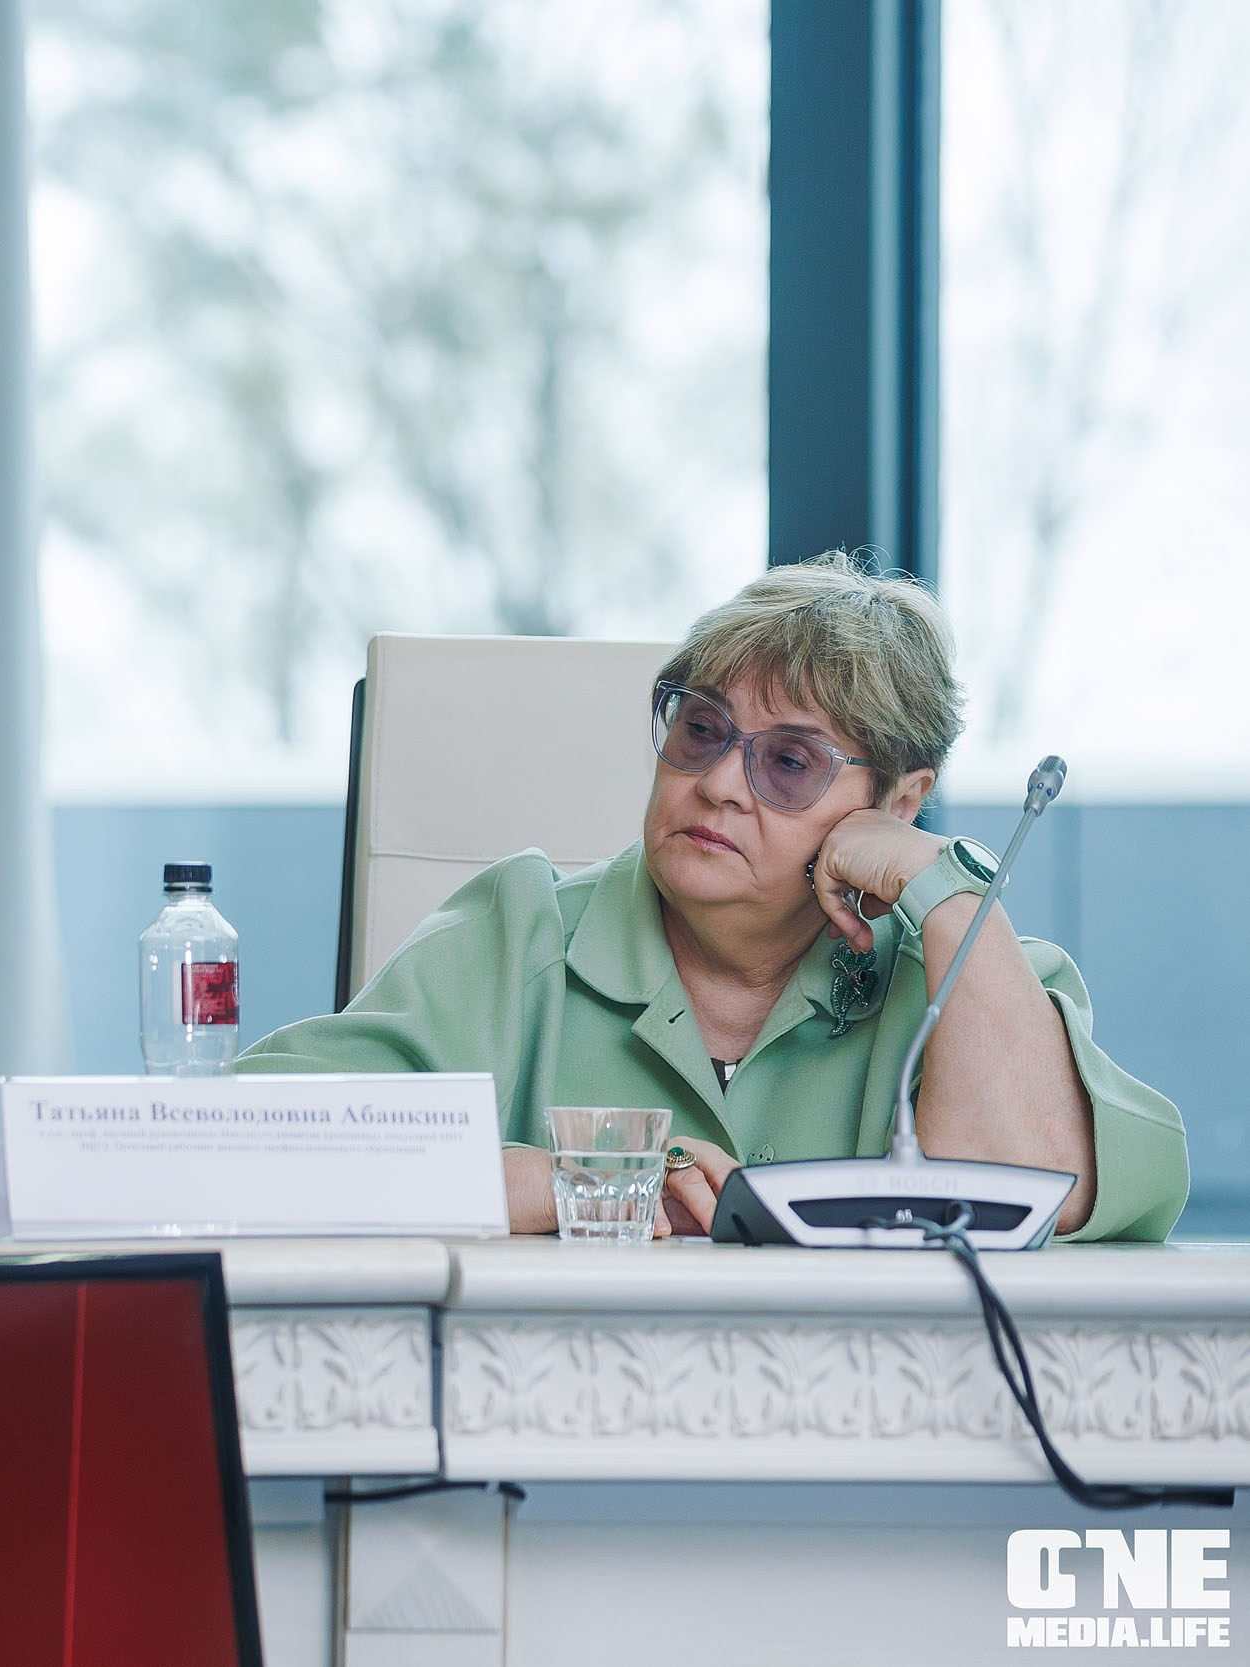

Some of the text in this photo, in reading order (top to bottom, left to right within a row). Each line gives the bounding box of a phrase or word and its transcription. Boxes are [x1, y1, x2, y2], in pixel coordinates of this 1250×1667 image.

[30, 1100, 470, 1126] Татьяна Всеволодовна Абанкина
[889, 1175, 958, 1192] BOSCH
